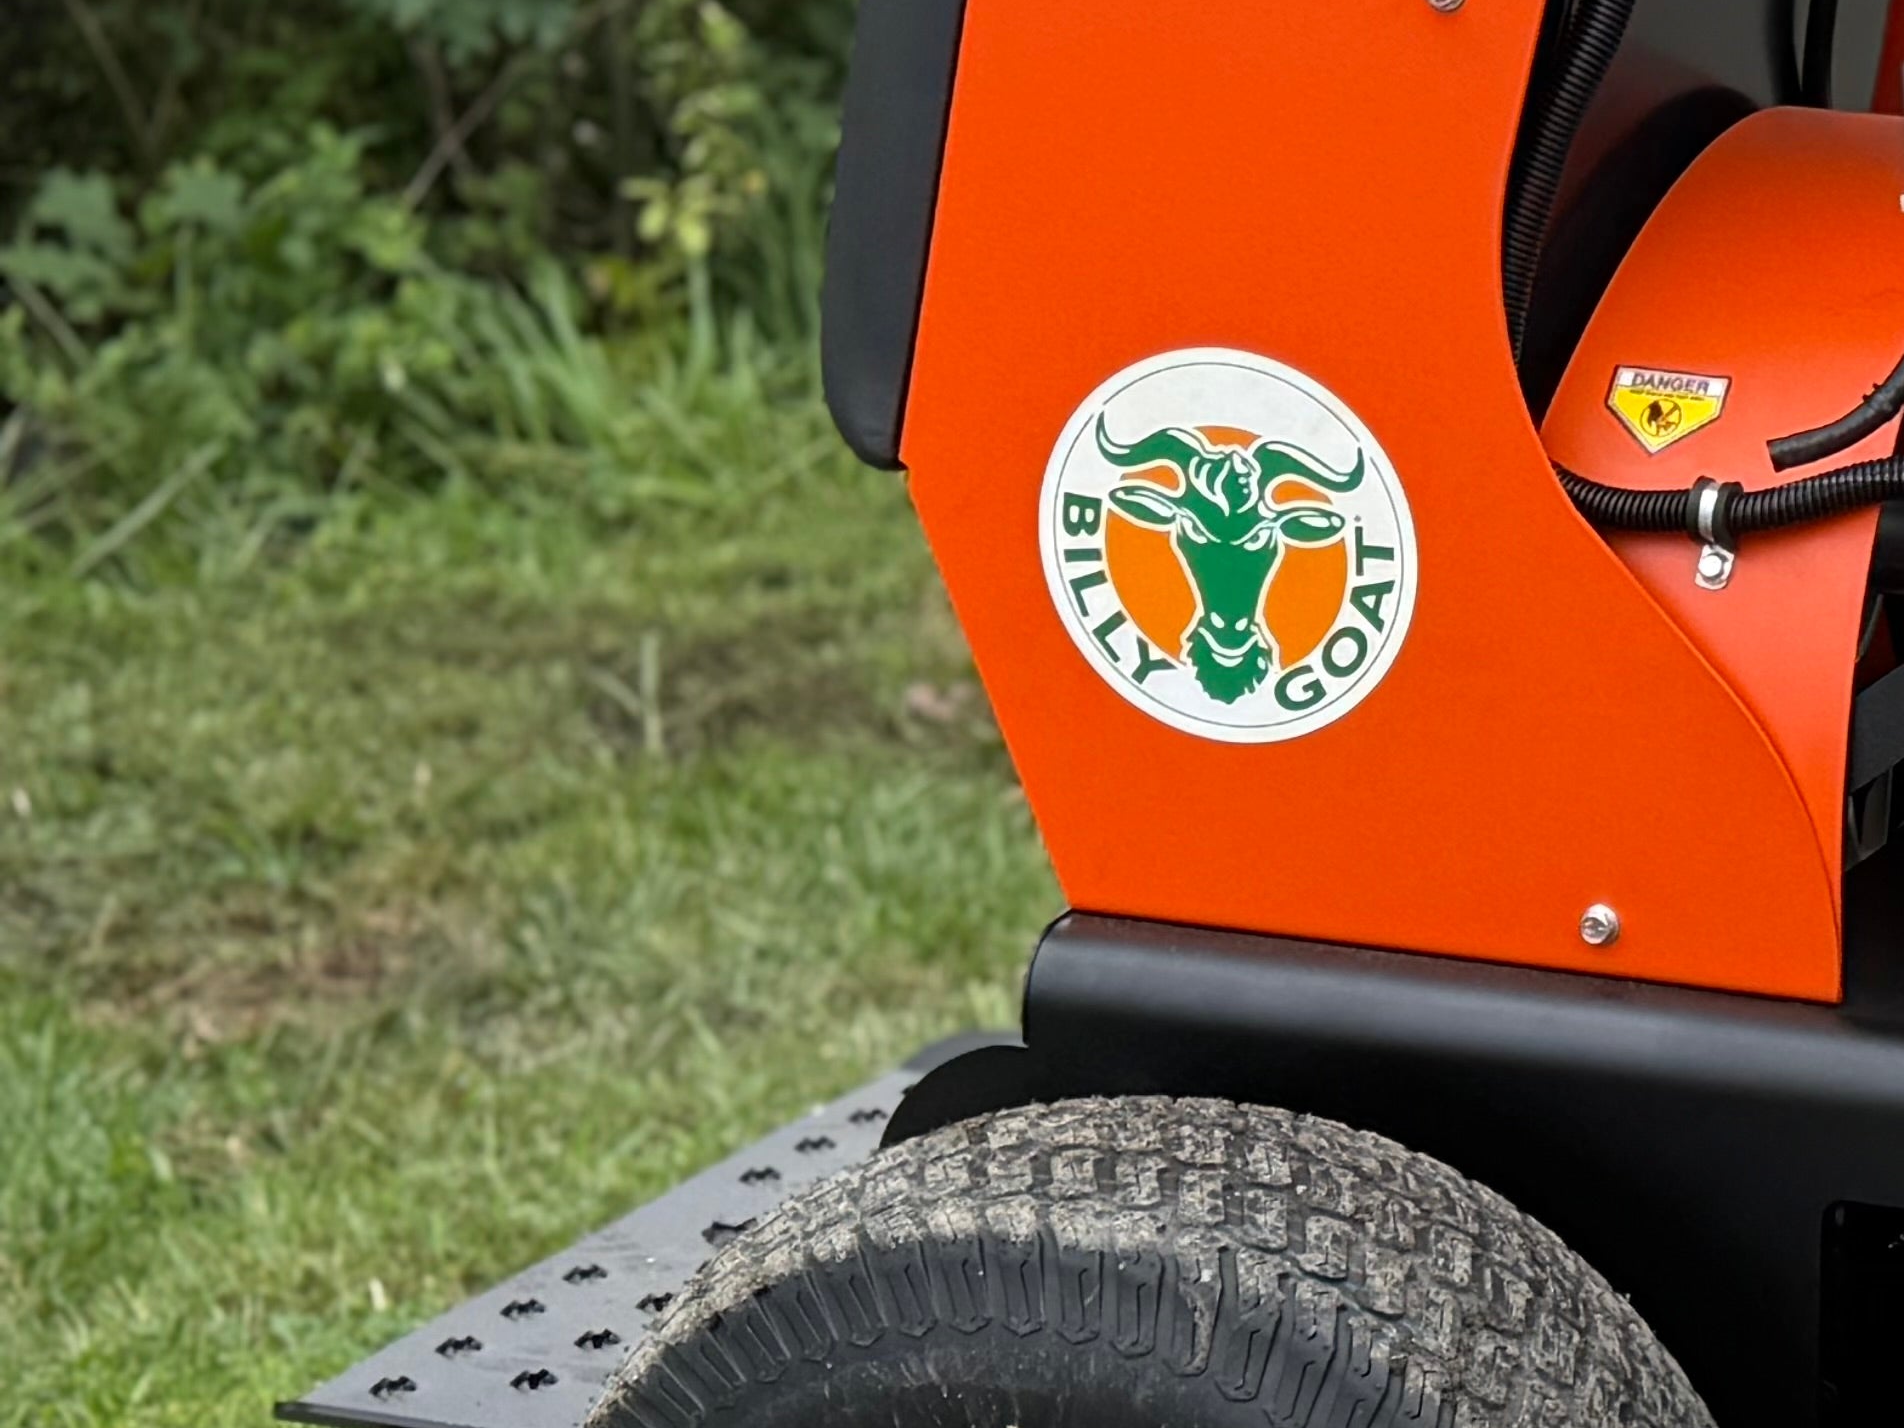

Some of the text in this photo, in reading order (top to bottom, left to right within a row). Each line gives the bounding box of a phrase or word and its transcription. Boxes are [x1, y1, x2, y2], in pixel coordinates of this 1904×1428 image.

[1631, 373, 1710, 396] DANGER
[1062, 491, 1396, 712] BILLY GOAT
